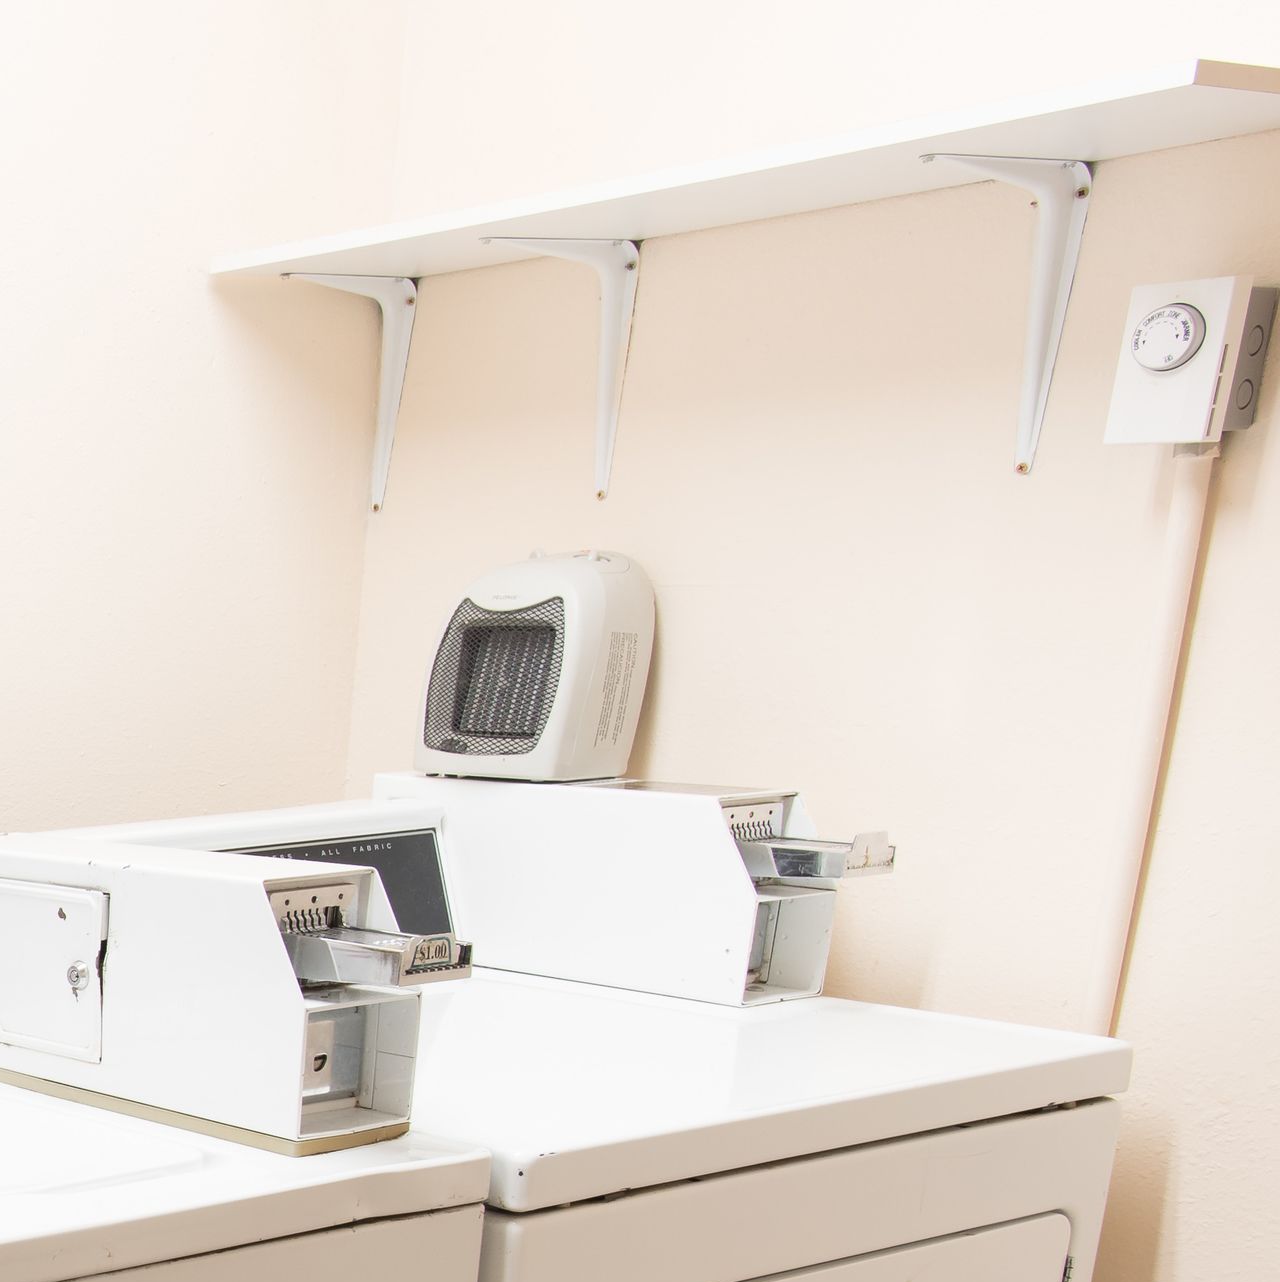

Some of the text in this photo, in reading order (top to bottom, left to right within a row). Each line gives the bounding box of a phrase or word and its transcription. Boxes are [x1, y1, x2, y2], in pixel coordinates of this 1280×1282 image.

[321, 842, 393, 857] ALL FABRIC
[418, 942, 447, 961] $1.00
